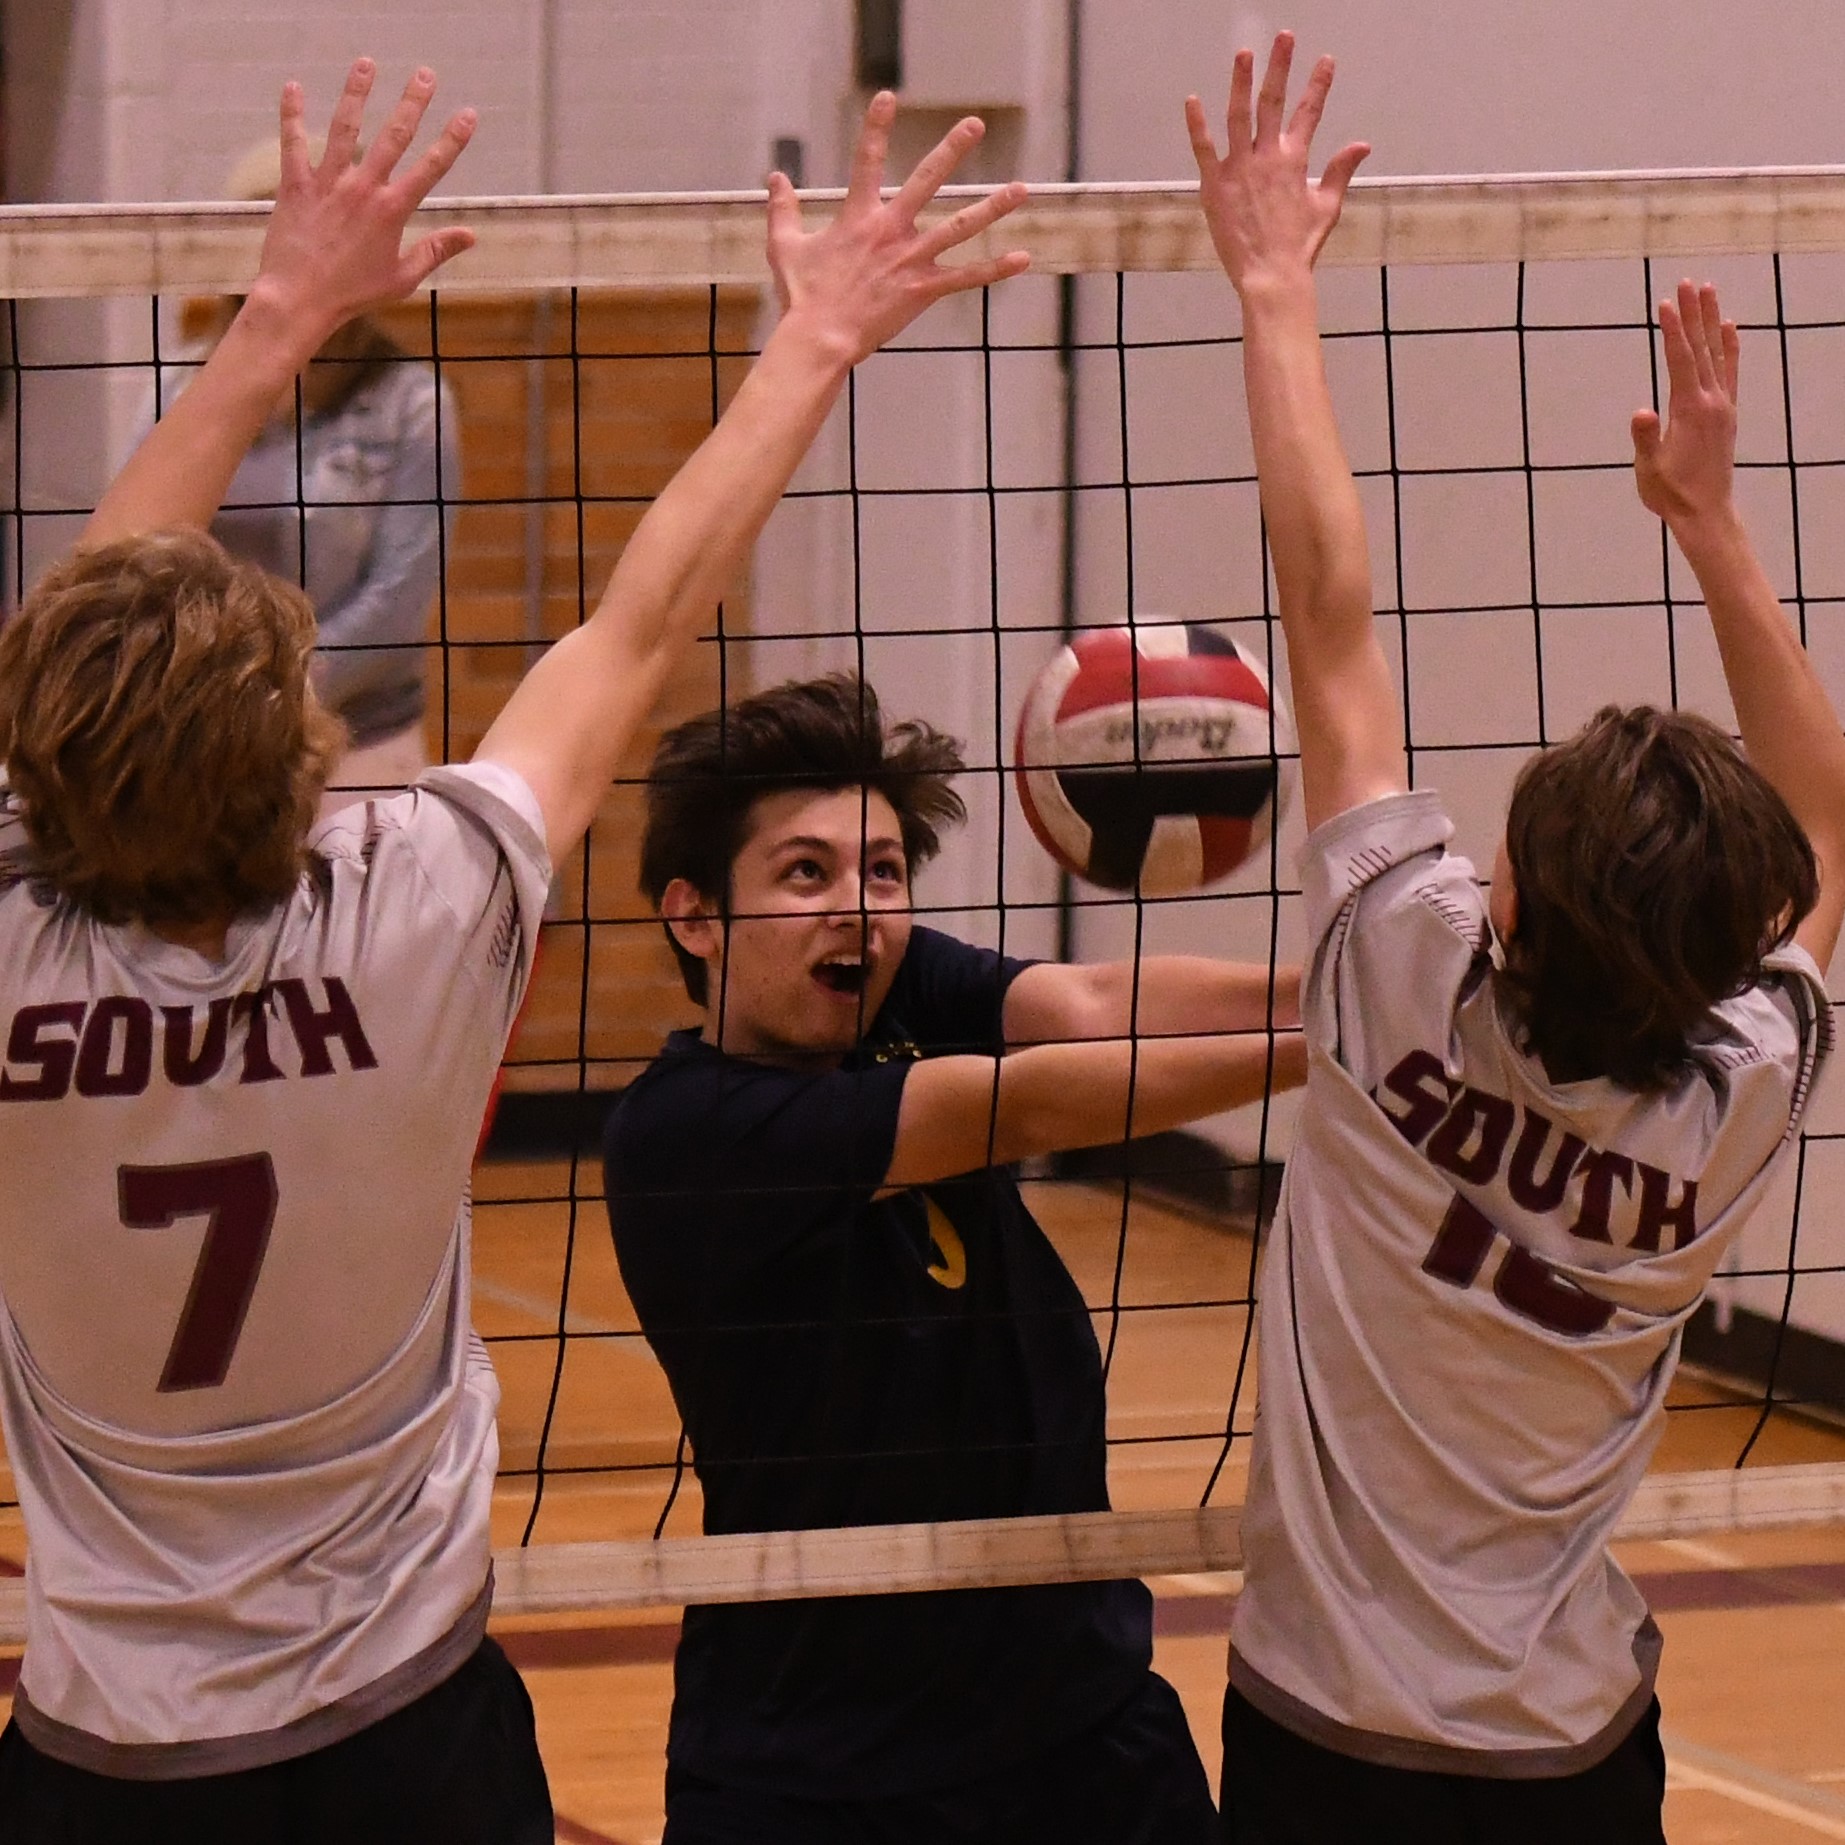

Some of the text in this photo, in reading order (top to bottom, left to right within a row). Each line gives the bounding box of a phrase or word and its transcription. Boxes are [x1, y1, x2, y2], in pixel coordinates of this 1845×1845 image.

[0, 976, 378, 1102] SOUTH
[1369, 1049, 1698, 1253] SOUTH
[117, 1151, 279, 1393] 7
